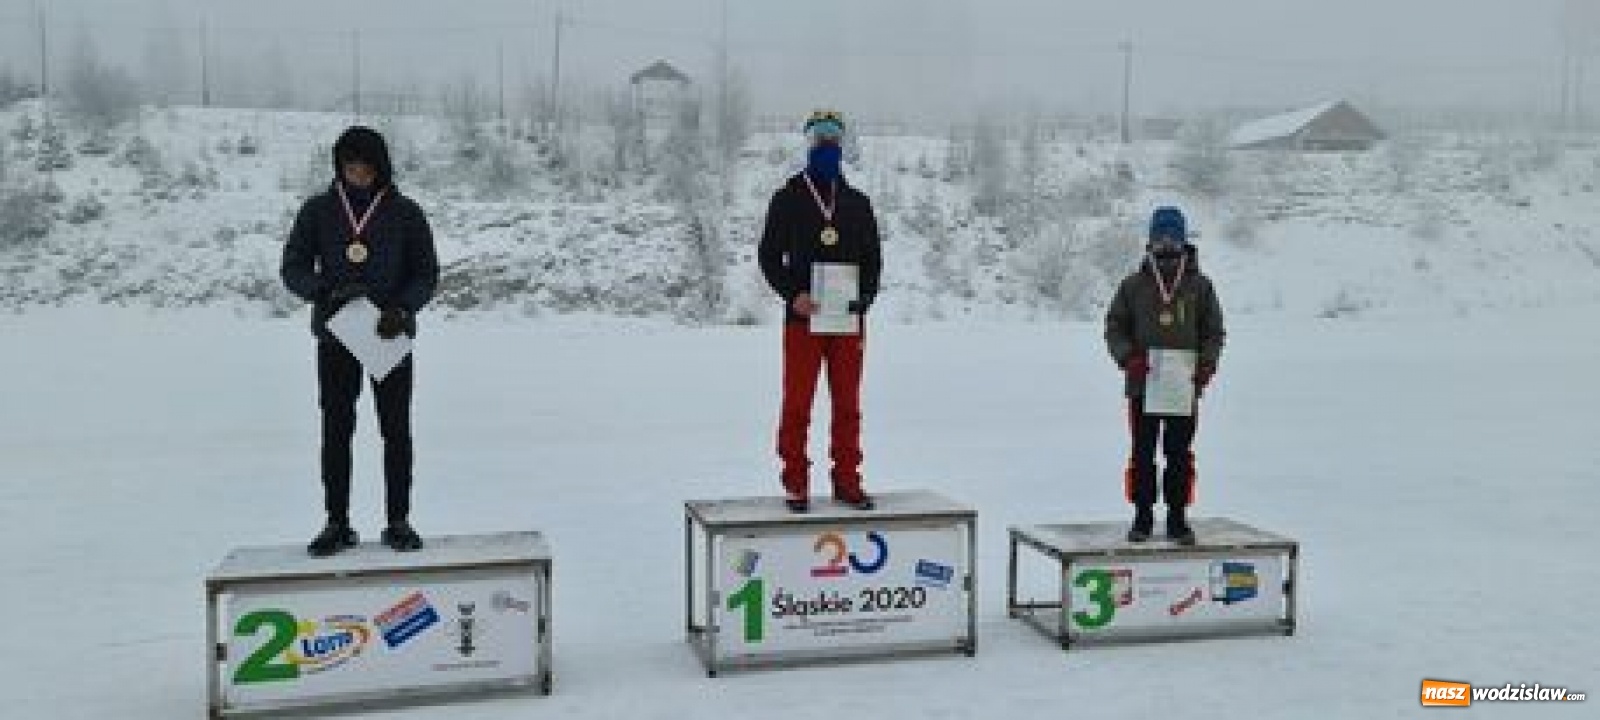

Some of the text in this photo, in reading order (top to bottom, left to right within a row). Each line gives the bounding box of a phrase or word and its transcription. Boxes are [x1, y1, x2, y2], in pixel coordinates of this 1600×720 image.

[727, 578, 764, 642] 1
[859, 587, 927, 612] 2020
[1072, 569, 1115, 628] 3
[233, 609, 300, 684] 2
